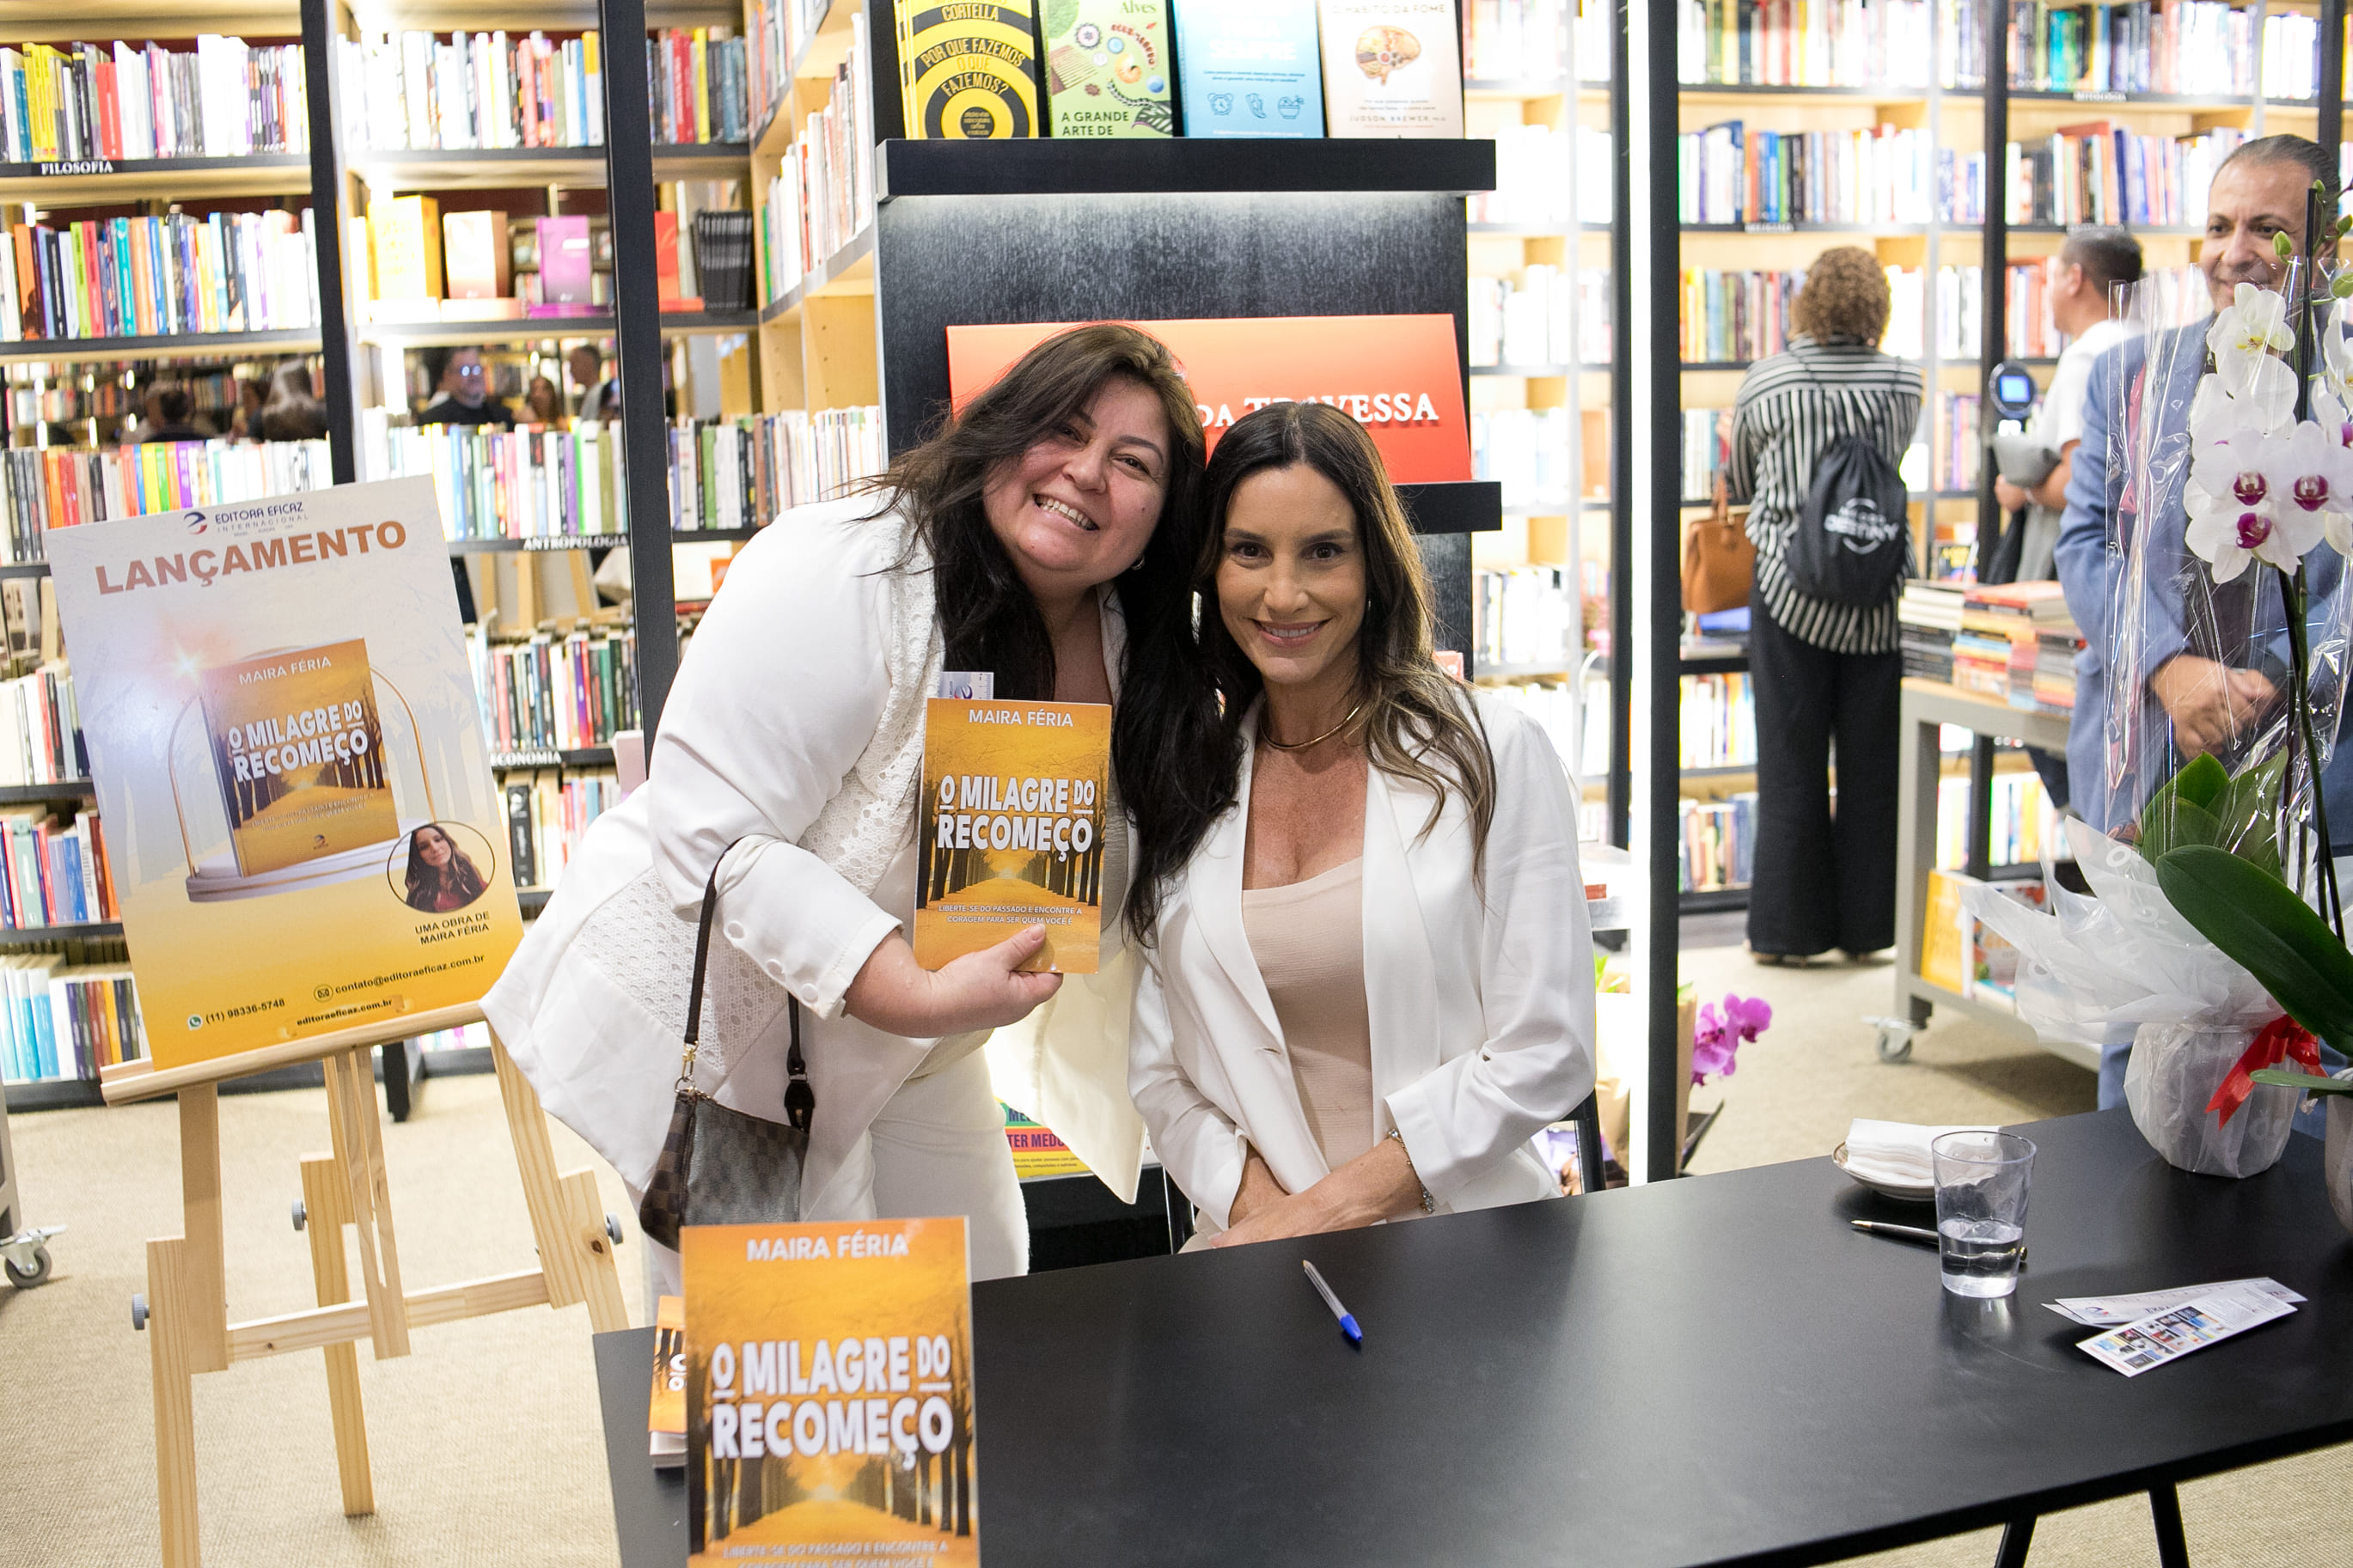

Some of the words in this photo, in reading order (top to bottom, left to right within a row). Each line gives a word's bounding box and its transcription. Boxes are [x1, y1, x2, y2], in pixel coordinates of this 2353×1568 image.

[941, 3, 999, 21] CORTELLA
[1120, 0, 1157, 14] Alves
[920, 46, 947, 68] POR
[946, 38, 971, 57] QUE
[972, 38, 1026, 68] FAZEMOS
[956, 57, 964, 71] O
[968, 56, 991, 70] QUE
[940, 73, 1010, 97] FAZEMOS?
[1061, 112, 1071, 122] A
[1074, 112, 1129, 122] GRANDE
[1062, 125, 1094, 136] ARTE
[1097, 125, 1114, 135] DE
[41, 161, 113, 175] FILOSOFIA
[1195, 404, 1235, 427] DA
[1244, 394, 1439, 423] TVESSA
[215, 507, 264, 525] EDITORA
[267, 502, 304, 516] EFICAZ
[217, 514, 309, 534] INTERNACIONAL
[523, 534, 628, 551] ANTROPOLOGIA
[95, 521, 407, 595] LANÇAMENTO
[238, 666, 287, 686] MAIRA
[290, 656, 332, 674] FÉRIA
[229, 727, 242, 750] O
[246, 705, 342, 750] MILAGRE
[343, 700, 363, 723] DO
[969, 709, 1022, 725] MAIRA
[1027, 709, 1073, 727] FÉRIA
[234, 729, 368, 783] RECOMEÇO
[490, 751, 562, 766] ECONOMIA
[940, 775, 956, 804] O
[960, 775, 1069, 813] MILAGRE
[1073, 778, 1095, 806] DO
[937, 814, 1093, 863] RECOMEÇO
[415, 922, 440, 935] UMA
[442, 915, 473, 930] OBRA
[475, 911, 490, 923] DE
[1021, 916, 1043, 924] QUEM
[420, 930, 456, 946] MAIRA
[457, 922, 490, 937] FÉRIA
[335, 955, 485, 994] contato@editoraeficaz.com.br
[205, 1010, 225, 1024] (11)
[227, 998, 285, 1021] 98336-5748
[296, 998, 393, 1027] editoraeficaz.com.br
[746, 1237, 830, 1261] MAIRA
[837, 1229, 909, 1260] FÉRIA
[712, 1342, 736, 1389] O
[743, 1337, 910, 1397] MILAGRE
[917, 1334, 951, 1378] DO
[712, 1396, 954, 1470] RECOMEÇO
[808, 1542, 862, 1556] PASSADO
[873, 1541, 937, 1554] ENCONTRE
[938, 1540, 948, 1553] A
